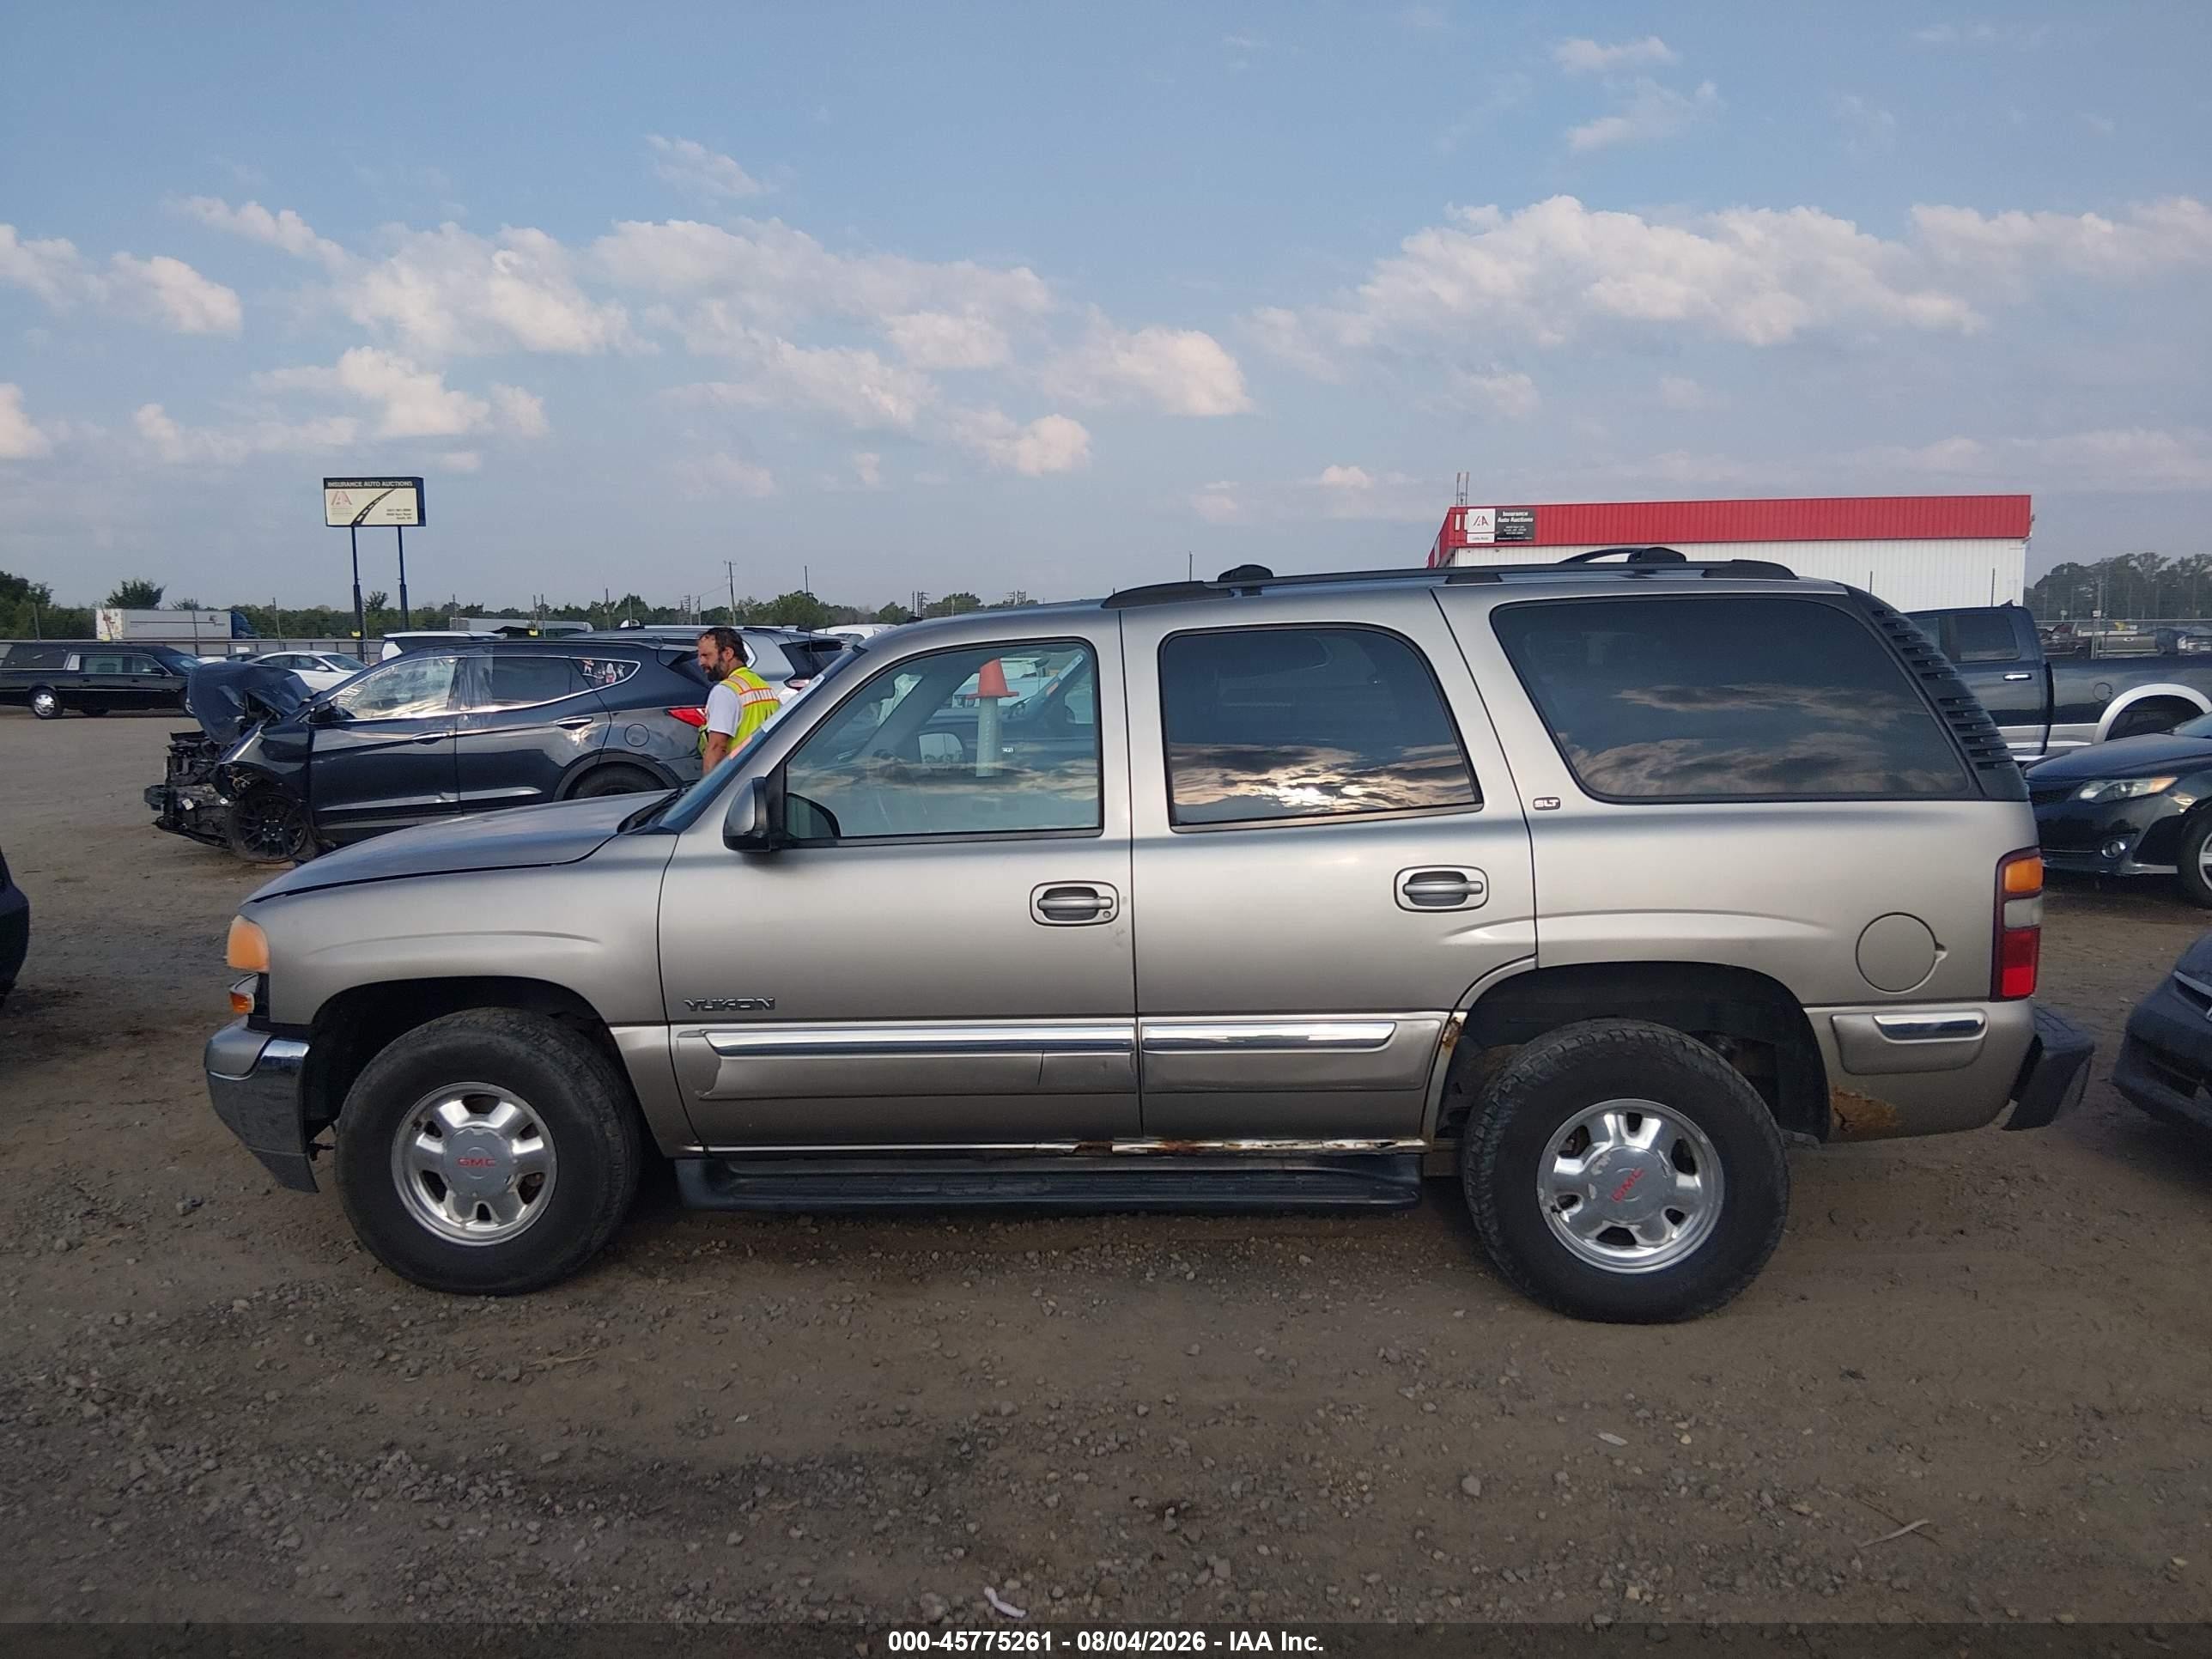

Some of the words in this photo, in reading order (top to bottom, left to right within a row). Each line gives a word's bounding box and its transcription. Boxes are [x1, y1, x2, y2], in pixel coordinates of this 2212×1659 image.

[1534, 799, 1559, 808] SLT
[684, 997, 775, 1012] YUKON
[457, 1157, 495, 1167] GMC
[1611, 1168, 1644, 1203] GMC
